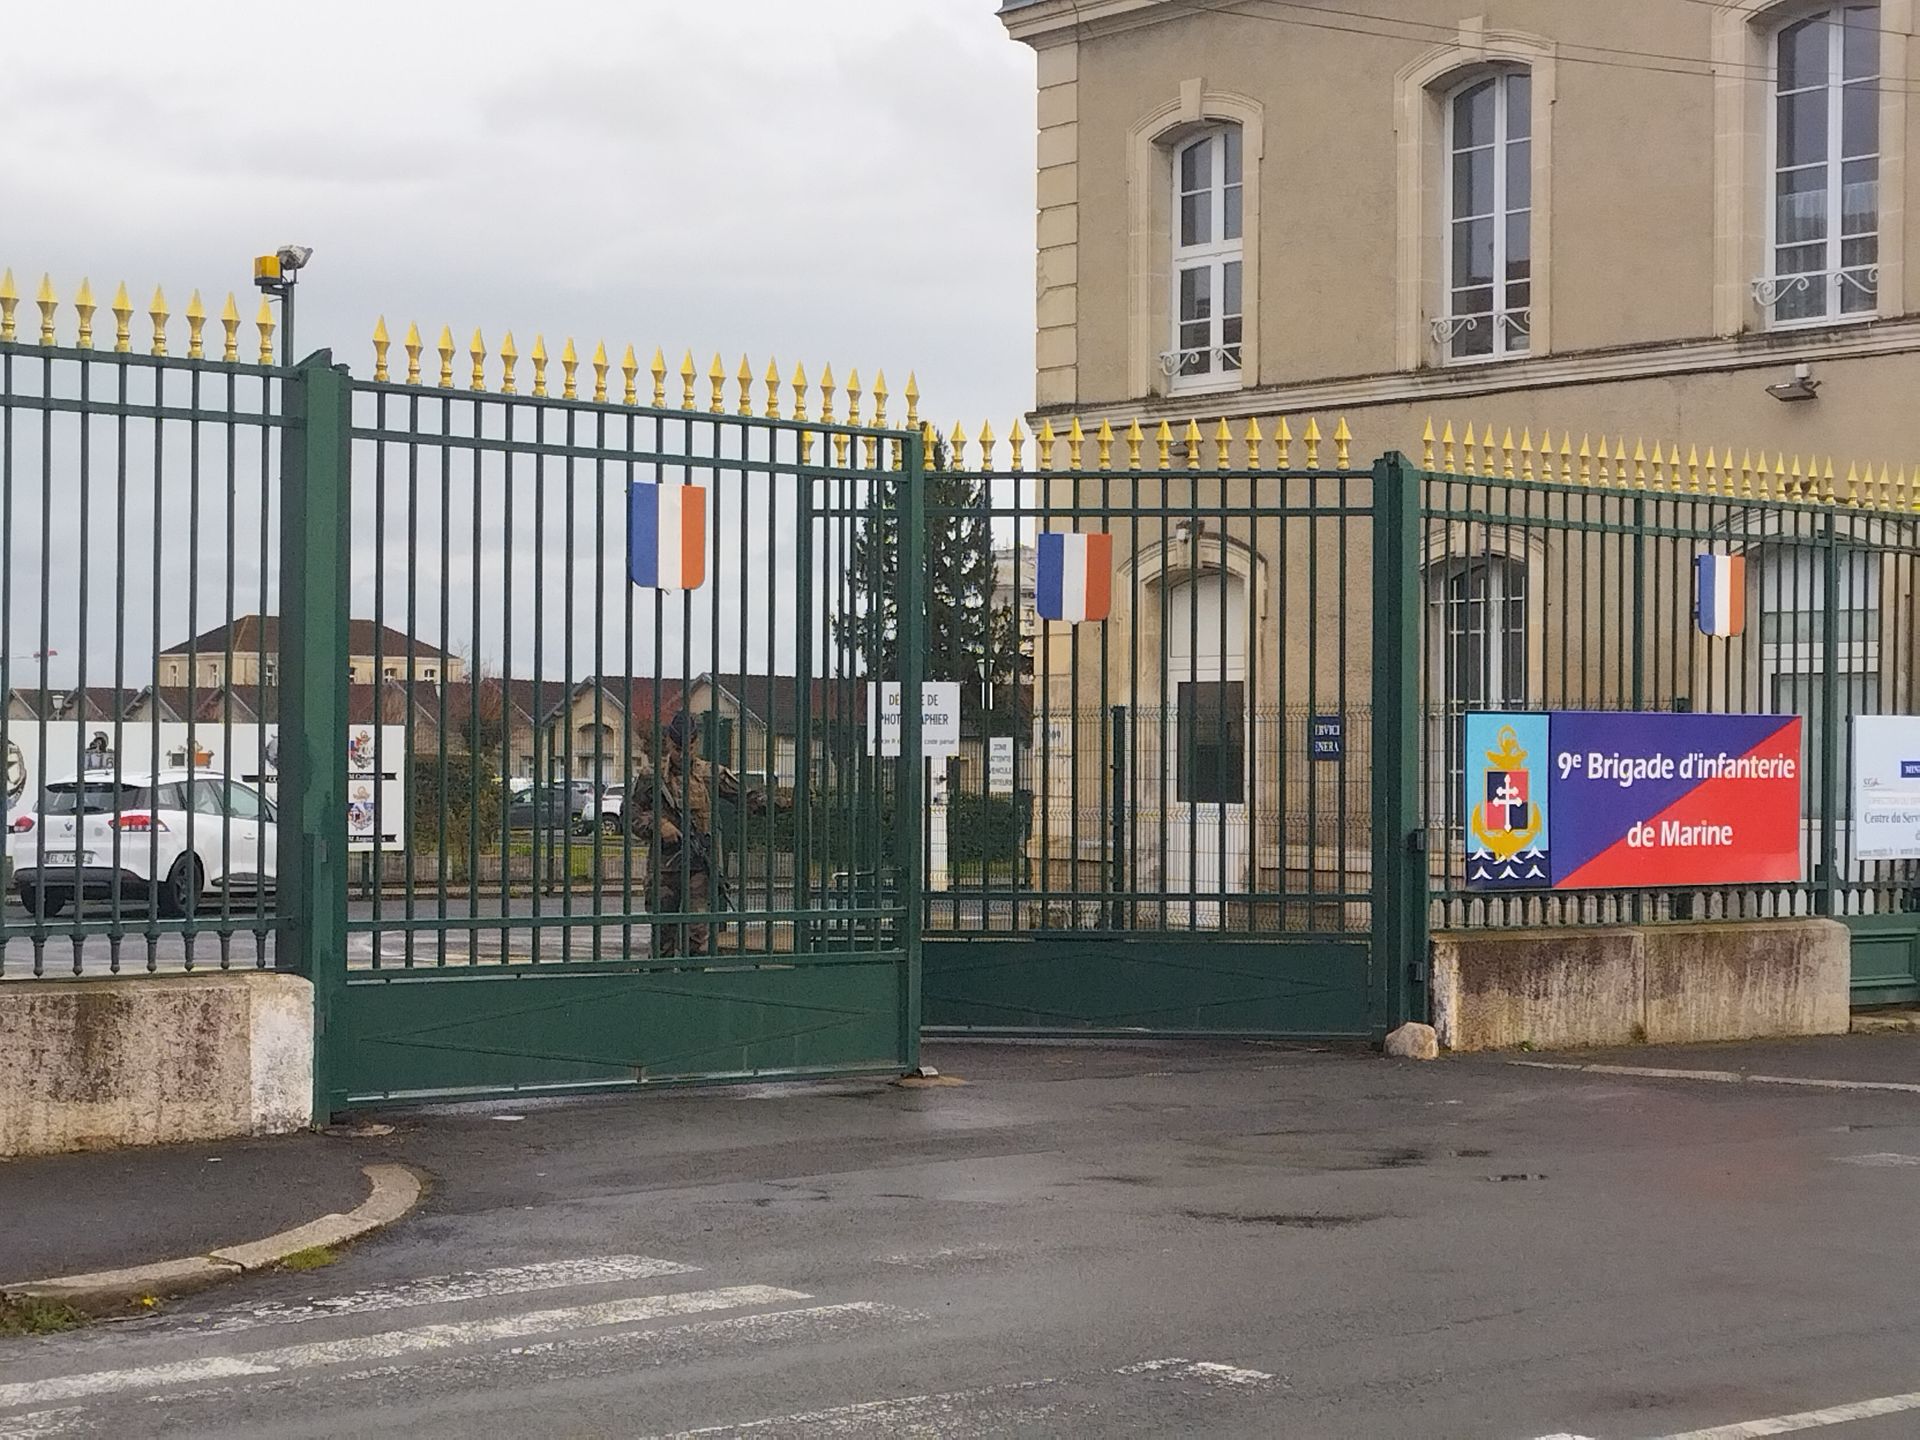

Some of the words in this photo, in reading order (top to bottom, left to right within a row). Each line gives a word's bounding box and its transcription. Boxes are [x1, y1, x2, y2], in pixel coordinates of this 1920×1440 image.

[927, 694, 939, 706] DE
[1588, 752, 1673, 787] Brigade
[1679, 752, 1796, 780] d'infanterie
[1864, 811, 1889, 824] Centre
[1627, 821, 1654, 848] de
[1660, 819, 1734, 848] Marine
